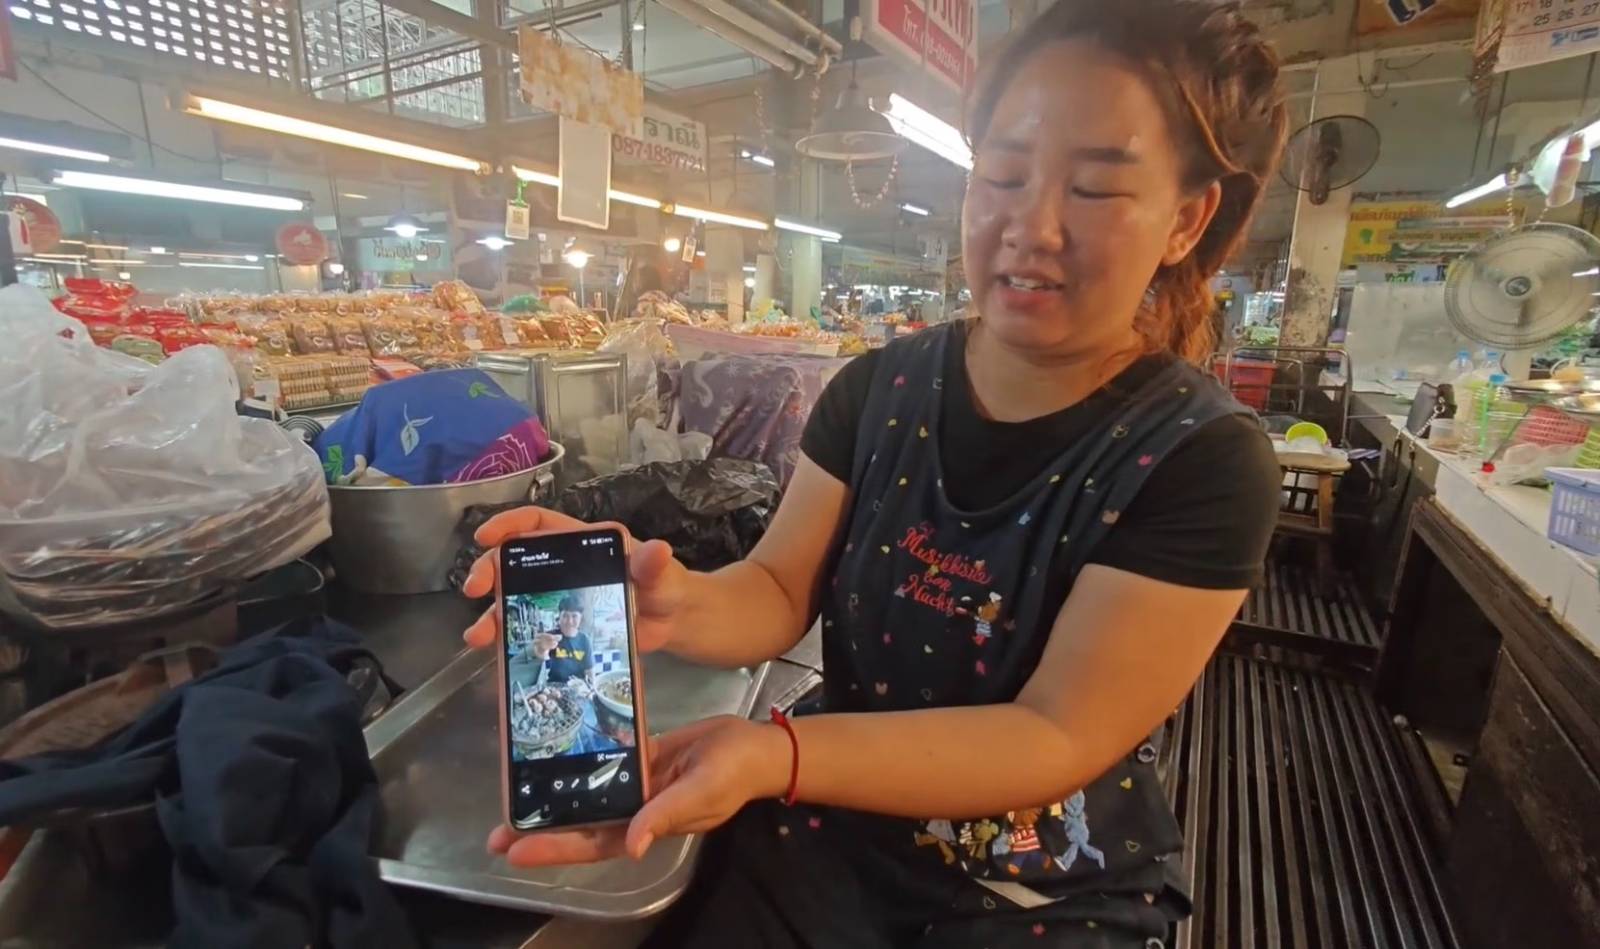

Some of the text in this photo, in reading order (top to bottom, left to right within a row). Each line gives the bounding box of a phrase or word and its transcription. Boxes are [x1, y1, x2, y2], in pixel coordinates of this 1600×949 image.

[1534, 2, 1600, 26] 25 26 27
